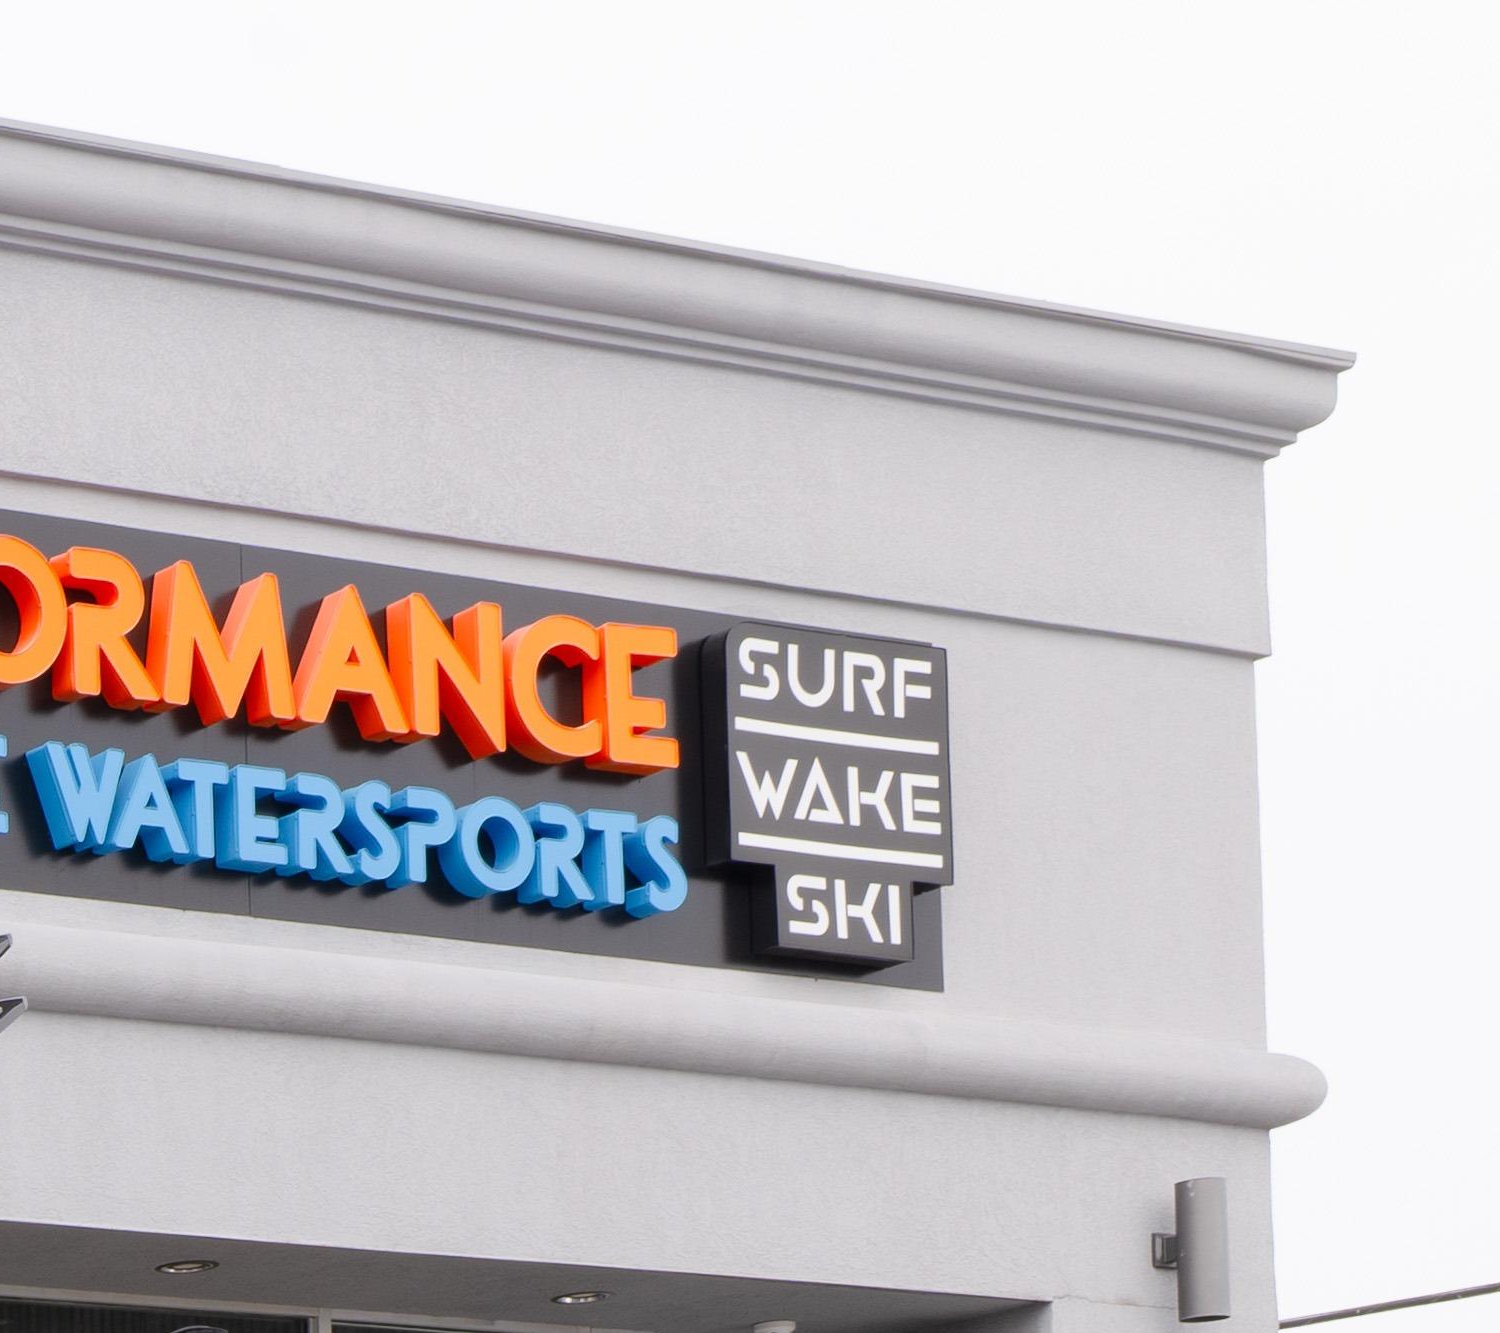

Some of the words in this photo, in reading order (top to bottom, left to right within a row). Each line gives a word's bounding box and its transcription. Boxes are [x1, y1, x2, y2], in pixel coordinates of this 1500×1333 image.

[738, 637, 932, 719] SURF
[25, 740, 688, 919] WATERSPORTS
[736, 750, 942, 835] WAKE
[786, 874, 902, 945] SKI
